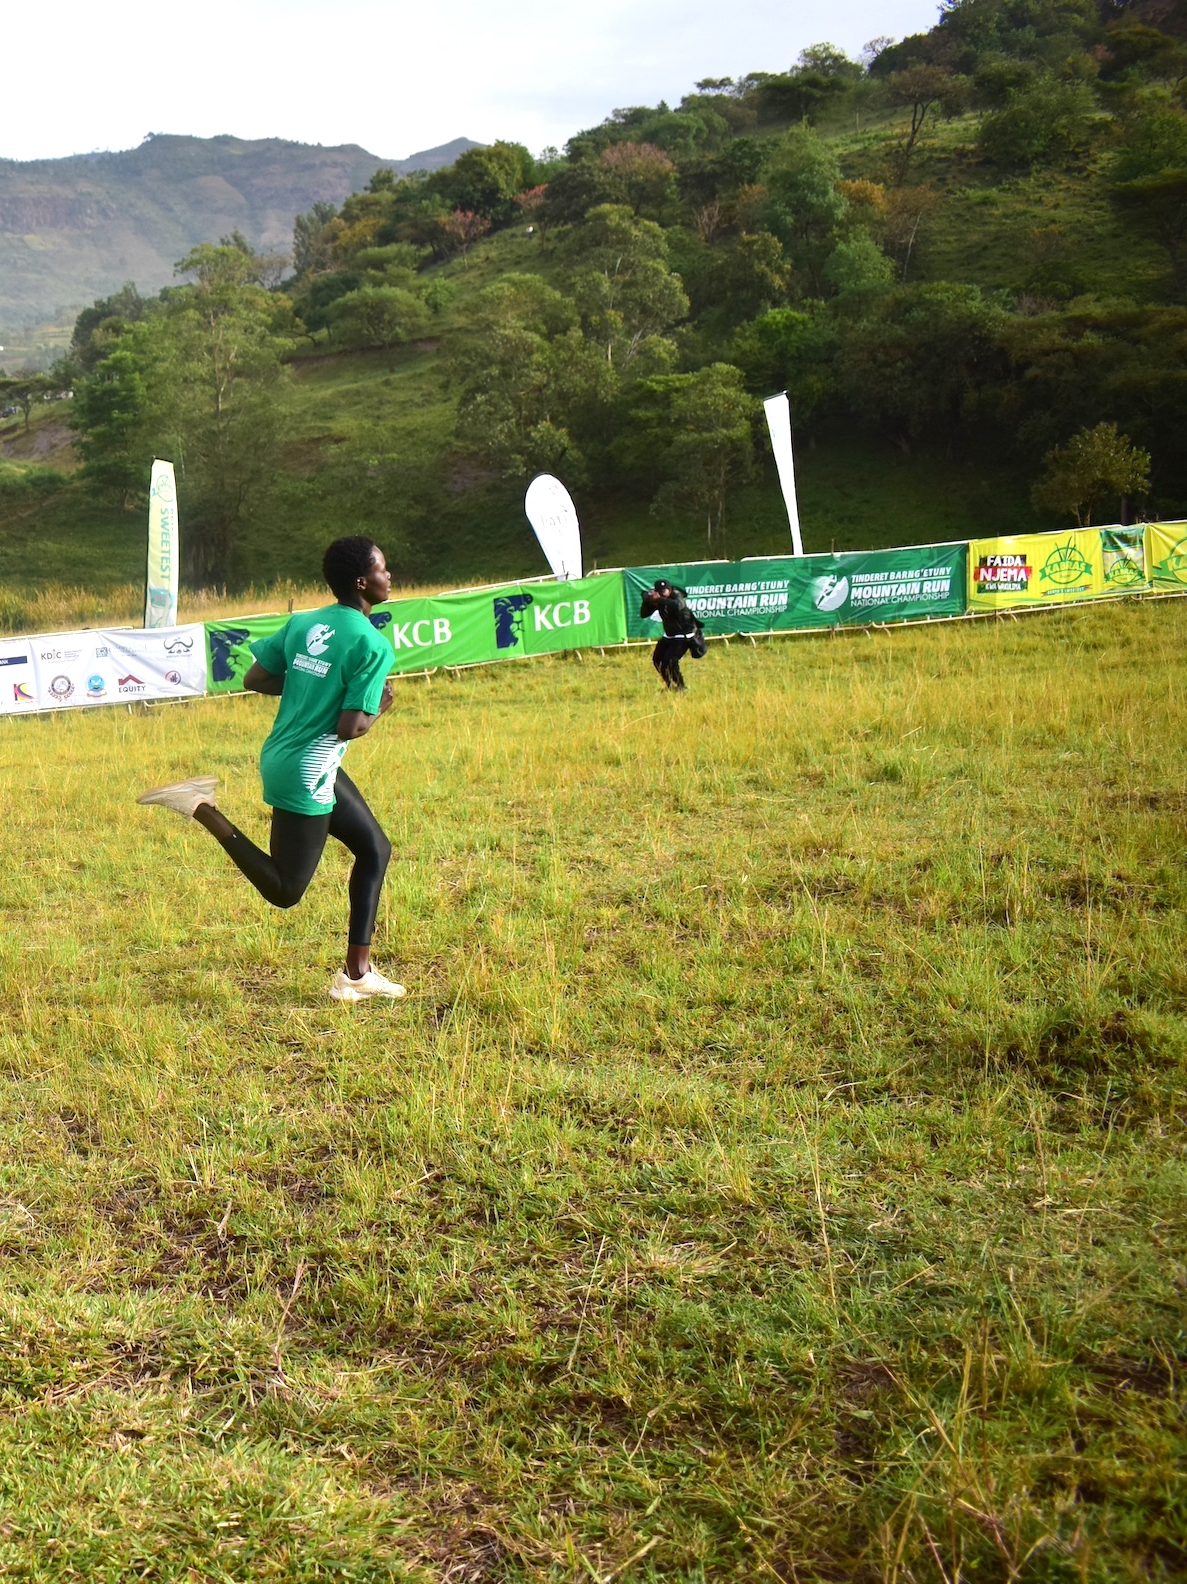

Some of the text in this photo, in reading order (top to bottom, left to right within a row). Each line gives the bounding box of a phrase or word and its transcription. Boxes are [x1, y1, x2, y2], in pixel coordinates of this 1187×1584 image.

[160, 508, 171, 582] SWEETEST
[986, 555, 1023, 567] FAIDA
[1044, 560, 1086, 576] KABRAS
[851, 567, 952, 583] TINDERET BARNG'ETUNY
[979, 567, 1028, 582] NJEMA
[685, 580, 790, 595] TINDERET BARNG'ETUNY
[850, 579, 951, 599] MOUNTAIN RUN
[686, 593, 788, 611] MOUNTAIN RUN
[850, 592, 950, 607] NATIONAL CHAMPIONSHIP
[533, 600, 591, 632] KCB
[693, 605, 788, 619] ATIONAL CHAMPIONSHIP
[392, 618, 453, 650] KCB
[118, 685, 146, 693] EQUITY
